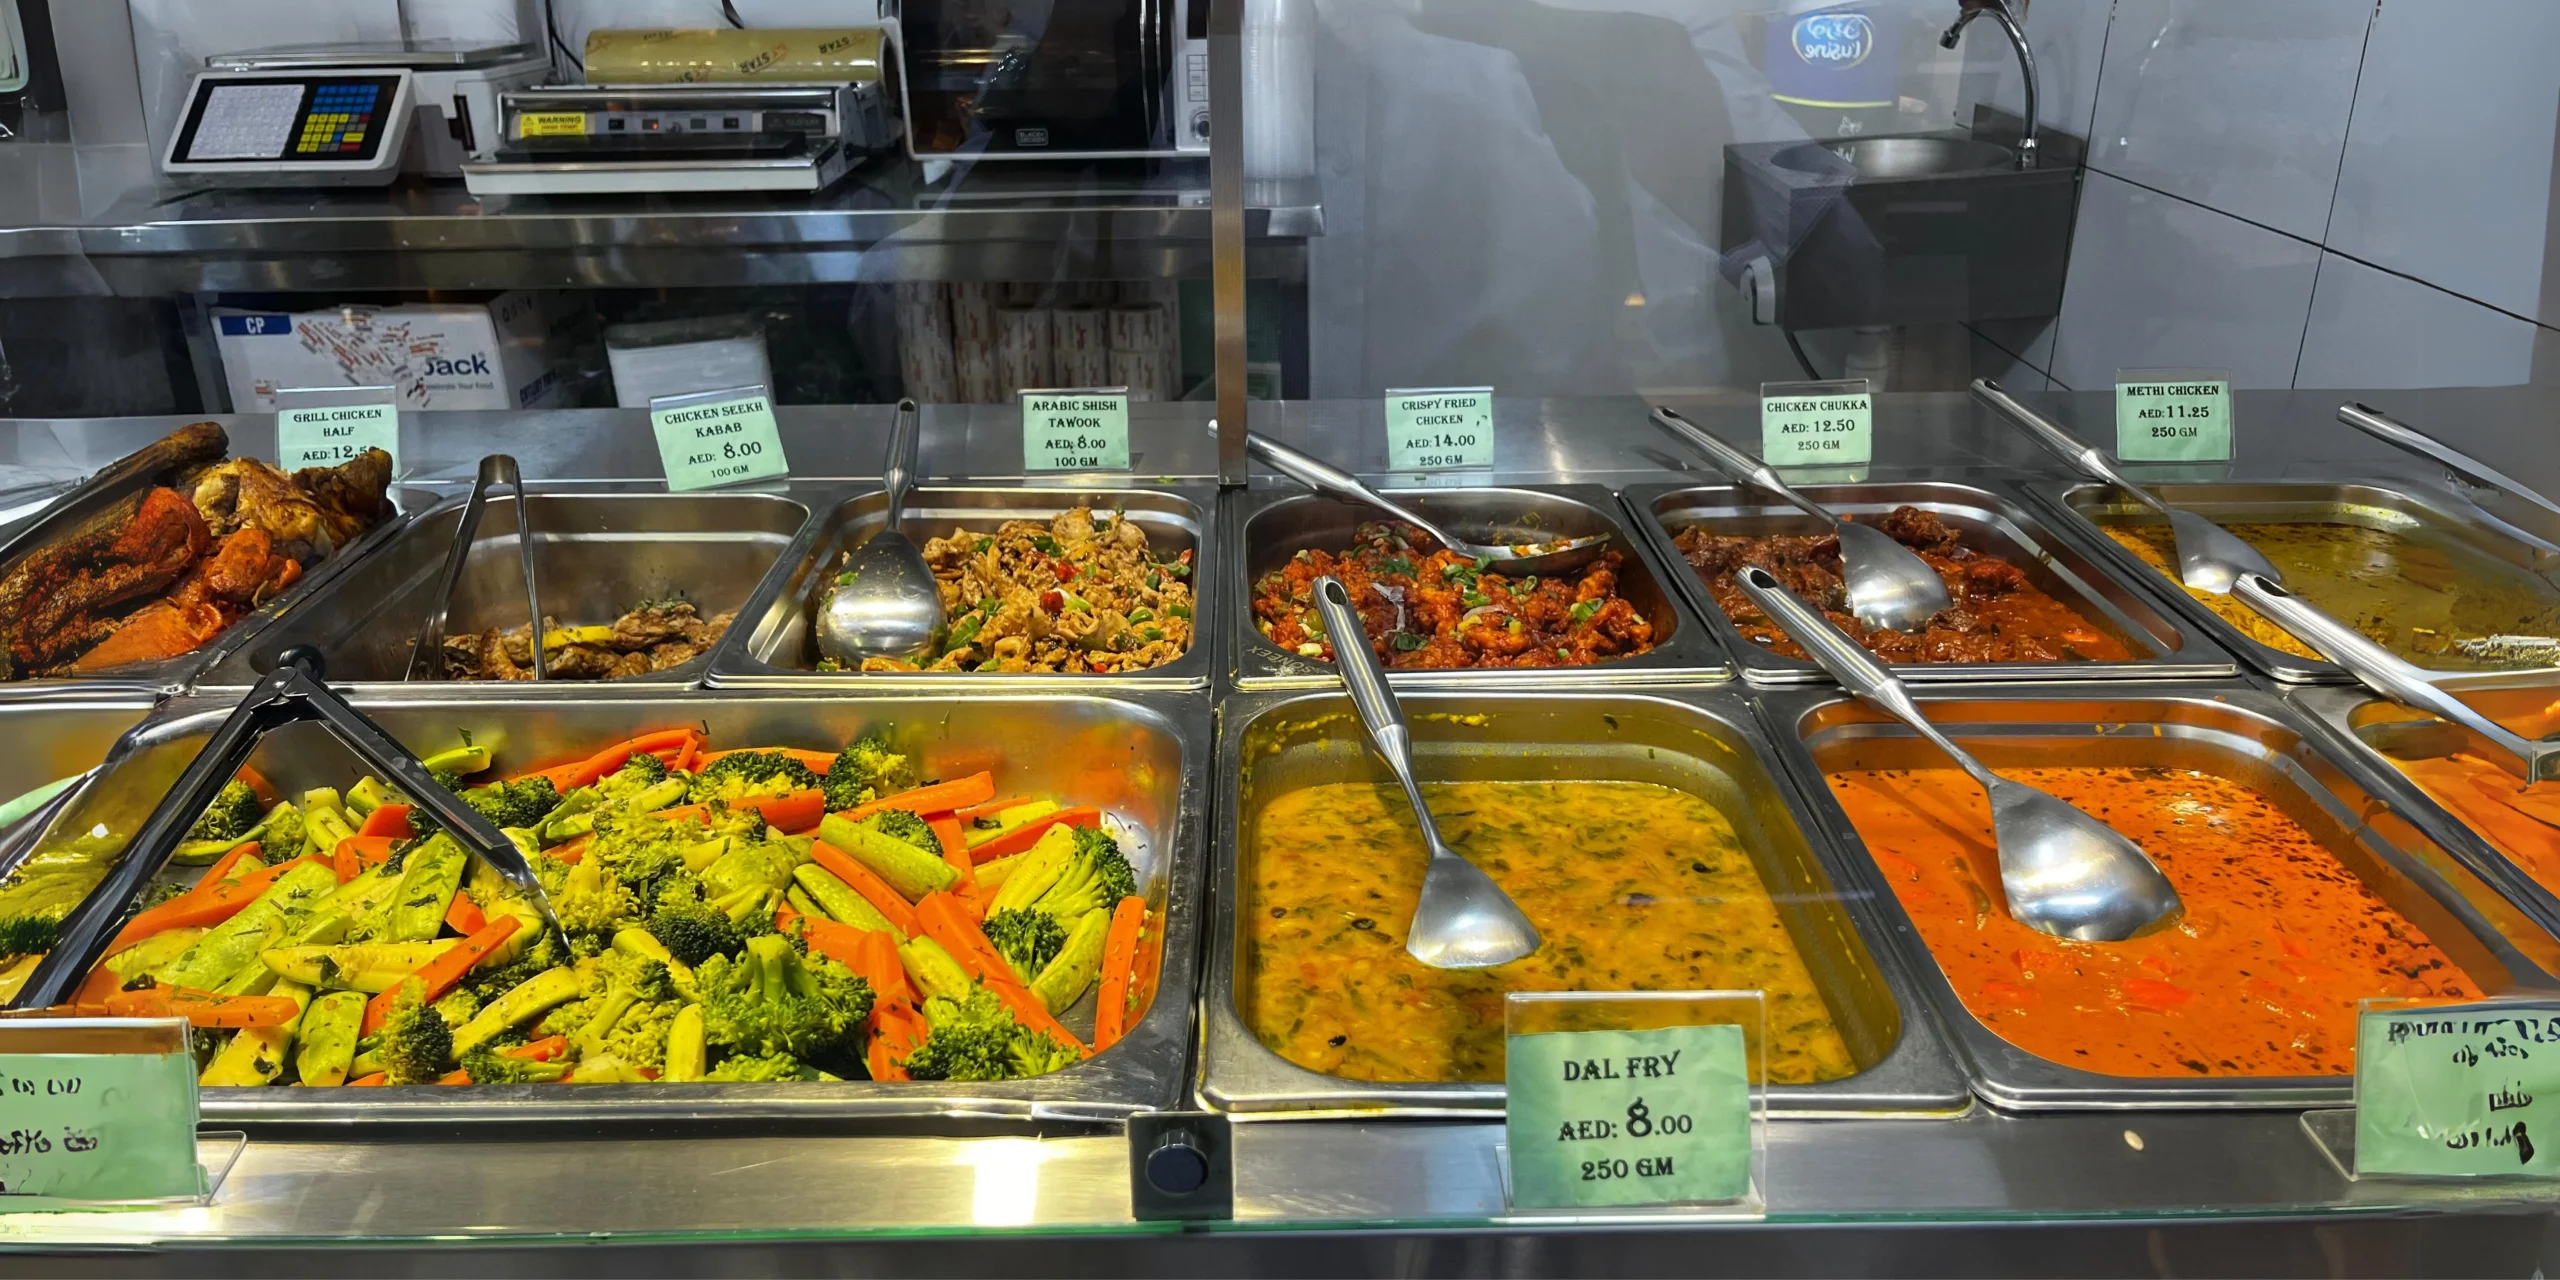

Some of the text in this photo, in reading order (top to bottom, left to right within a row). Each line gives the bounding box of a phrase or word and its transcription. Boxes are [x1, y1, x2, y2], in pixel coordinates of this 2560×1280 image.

[819, 36, 850, 55] STAR
[740, 51, 771, 74] STAR
[538, 116, 581, 125] WARNING
[245, 317, 265, 335] CP
[2127, 385, 2219, 396] METHI CHICKEN
[1032, 401, 1117, 411] ARABIC SHISH
[1401, 398, 1476, 410] CRISPY FRIED
[1767, 400, 1868, 412] CHICKEN CHUKKA
[293, 409, 382, 423] GRILL CHICKEN
[664, 402, 764, 425] CHICKEN SEEKH
[2166, 405, 2209, 418] 11.25
[1048, 416, 1101, 428] TAWOOK
[1416, 414, 1463, 426] CHICKEN
[1781, 419, 1855, 433] AED: 12.50
[323, 427, 355, 437] HALF
[696, 422, 743, 438] KABAB
[2151, 426, 2198, 438] 250 GM
[1077, 434, 1106, 449] 8.00
[1433, 434, 1476, 448] 14.00
[1797, 440, 1840, 451] 250 GM
[332, 445, 370, 459] 12.5
[688, 441, 762, 465] AED: 8.00
[1054, 457, 1099, 467] 100 GM
[1419, 454, 1463, 466] 250 GM
[711, 464, 749, 479] 100 GM
[1563, 1049, 1681, 1081] DAL FRY
[1557, 1096, 1693, 1141] AED: 8.00
[1581, 1156, 1675, 1181] 250 GM
